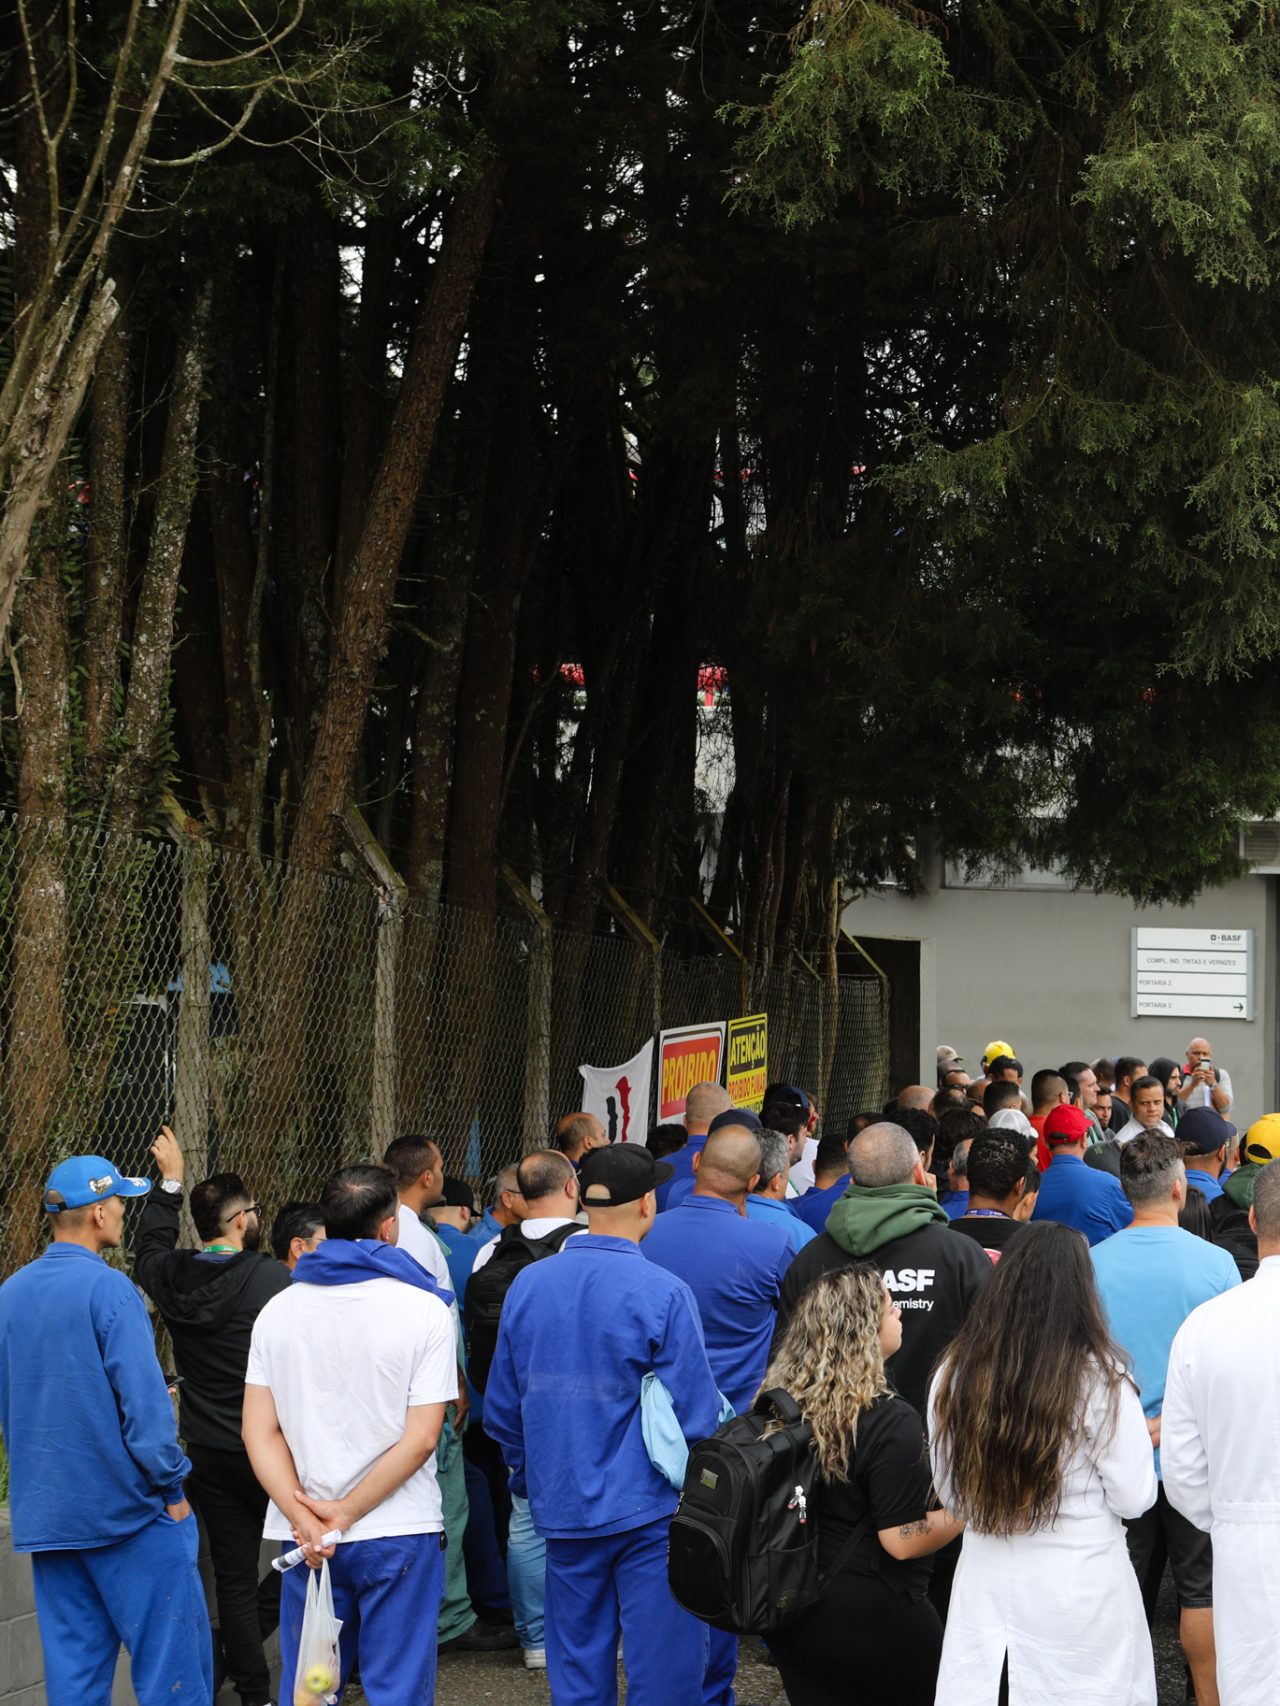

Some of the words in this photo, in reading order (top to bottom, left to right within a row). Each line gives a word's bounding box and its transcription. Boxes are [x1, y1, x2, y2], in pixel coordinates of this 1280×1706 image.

[730, 1025, 766, 1069] ATENÇÃO
[662, 1049, 717, 1106] PROIBIDO
[729, 1076, 750, 1102] PROIBIDO
[882, 1268, 936, 1292] ASF
[893, 1298, 934, 1312] emistry
